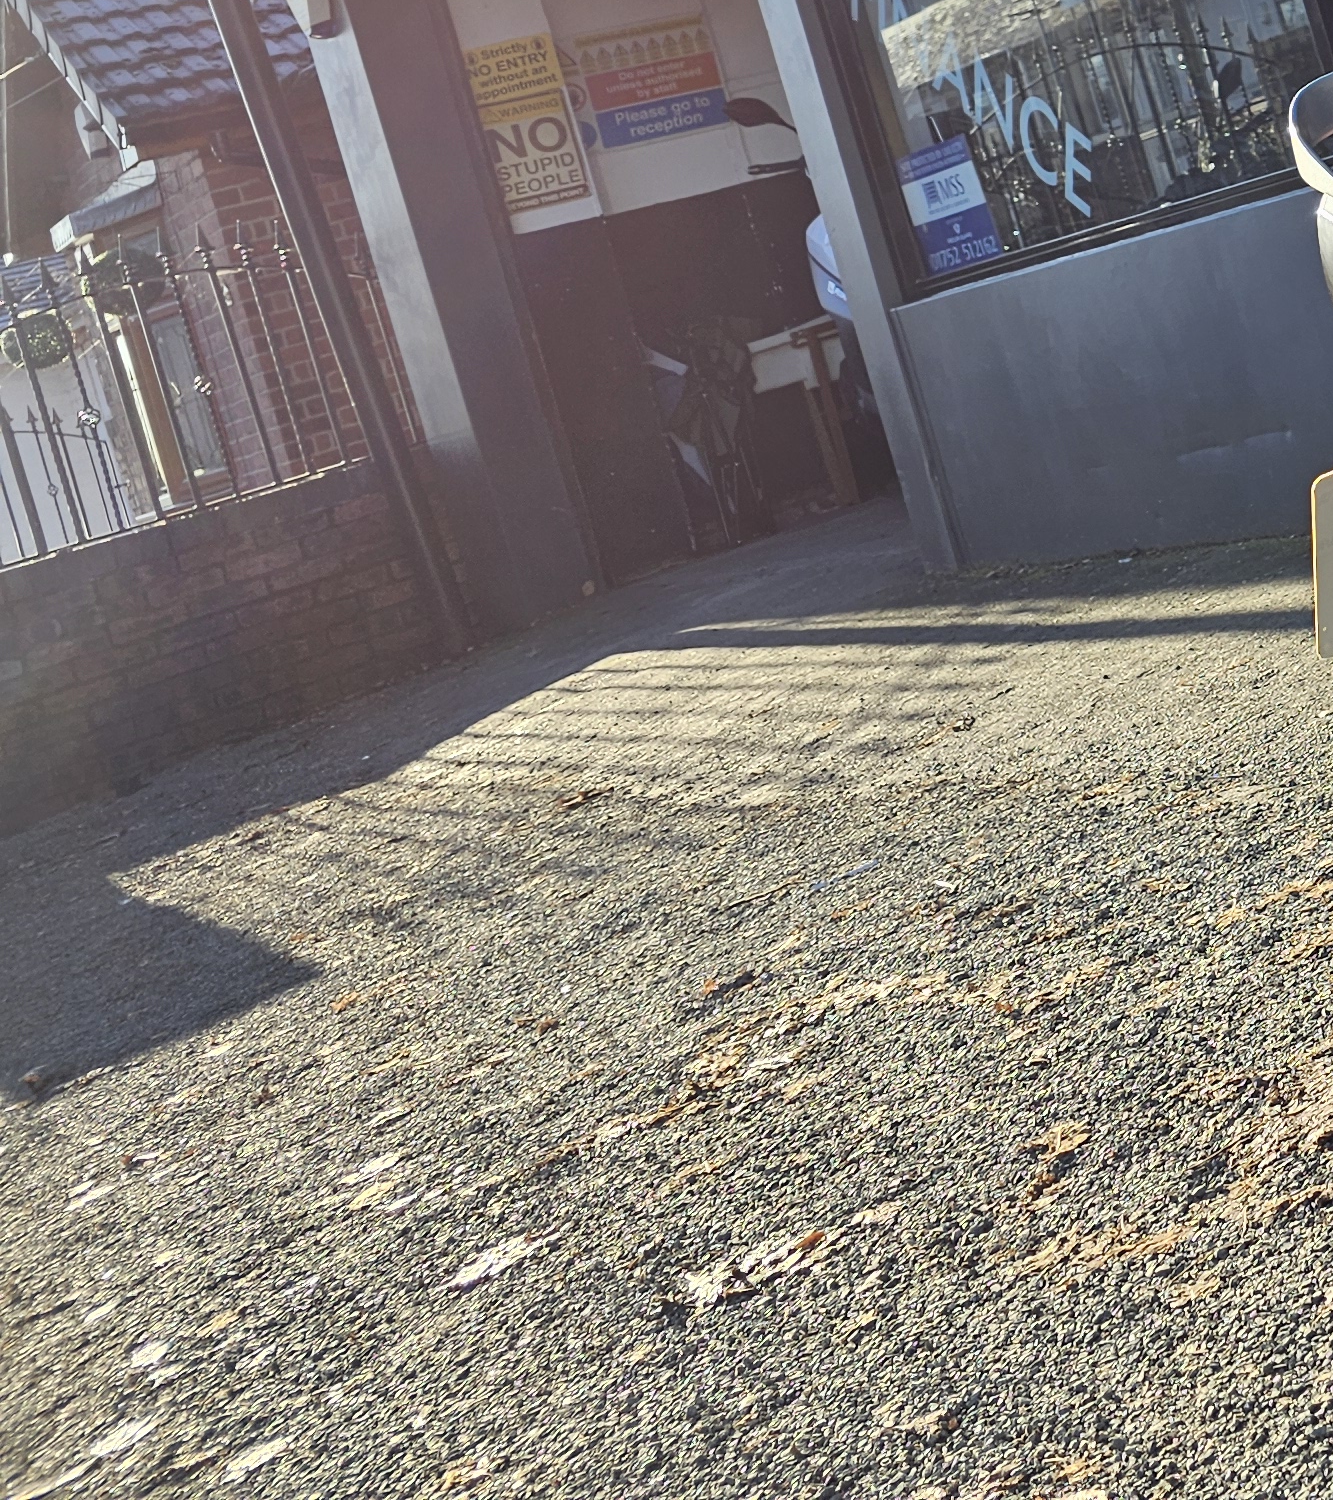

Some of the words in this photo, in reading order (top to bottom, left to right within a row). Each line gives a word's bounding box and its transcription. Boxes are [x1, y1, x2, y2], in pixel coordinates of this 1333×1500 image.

[469, 64, 491, 77] NO
[496, 51, 548, 72] ENTRY
[481, 42, 527, 60] Strictly
[478, 69, 530, 88] without
[531, 65, 548, 76] an
[618, 69, 634, 80] Do
[657, 61, 685, 72] enter
[476, 73, 558, 100] appointment
[498, 98, 560, 117] WARNING
[615, 106, 667, 125] Please
[671, 100, 691, 115] go
[695, 96, 710, 108] to
[630, 113, 704, 137] reception
[485, 117, 567, 163] NO
[497, 152, 574, 181] STUPID
[502, 169, 581, 195] PEOPLE
